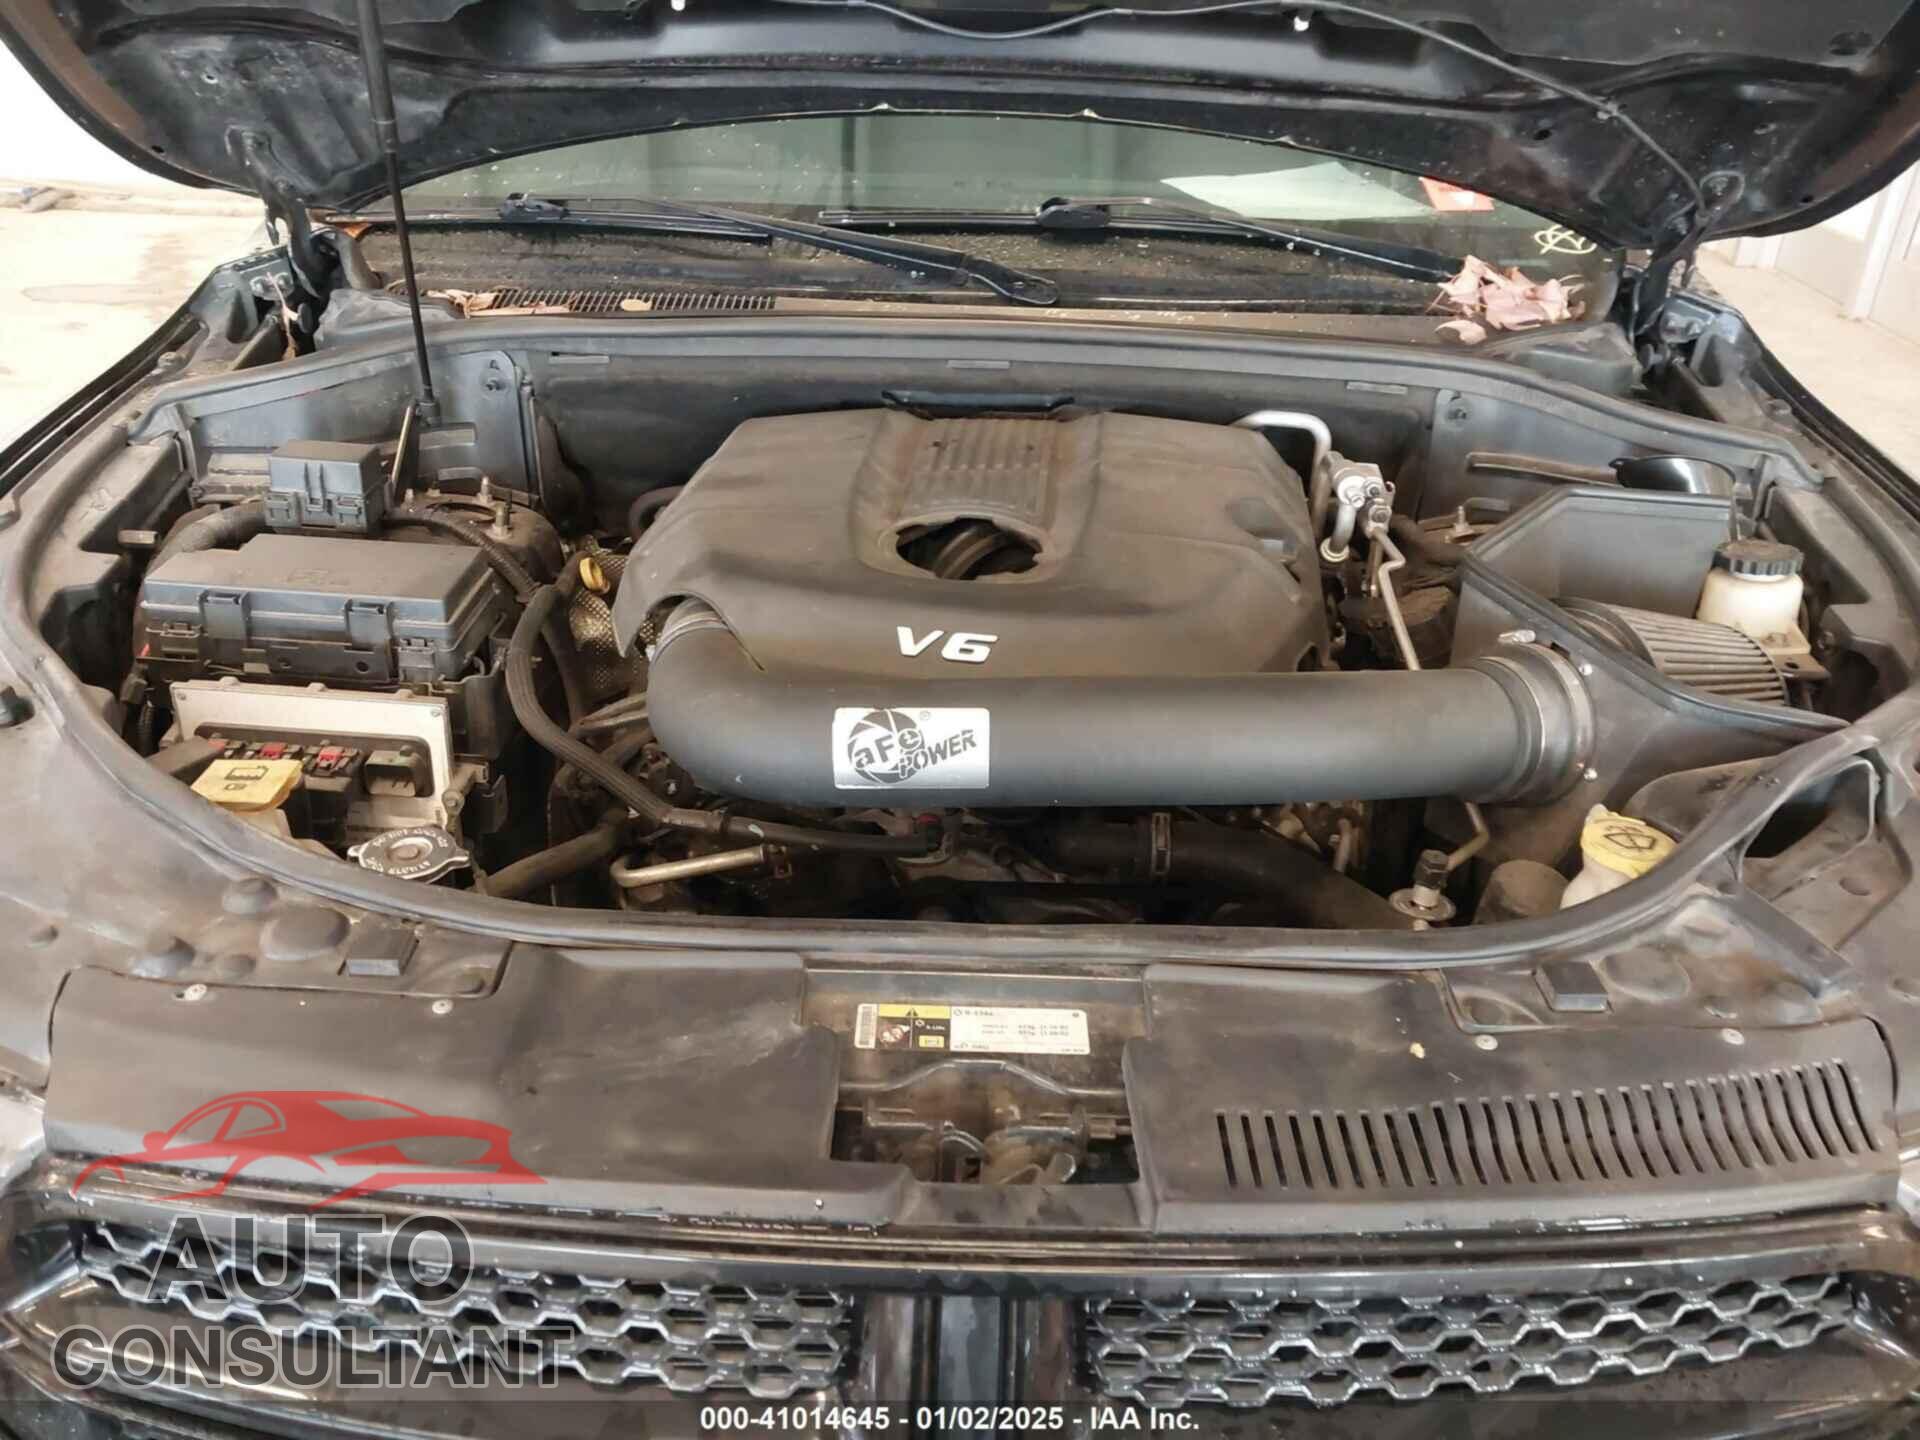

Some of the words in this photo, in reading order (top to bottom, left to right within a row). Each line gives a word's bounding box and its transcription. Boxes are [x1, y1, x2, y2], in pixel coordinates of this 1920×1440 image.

[896, 625, 999, 664] V6
[853, 729, 921, 770] aFe
[899, 729, 977, 778] POWER
